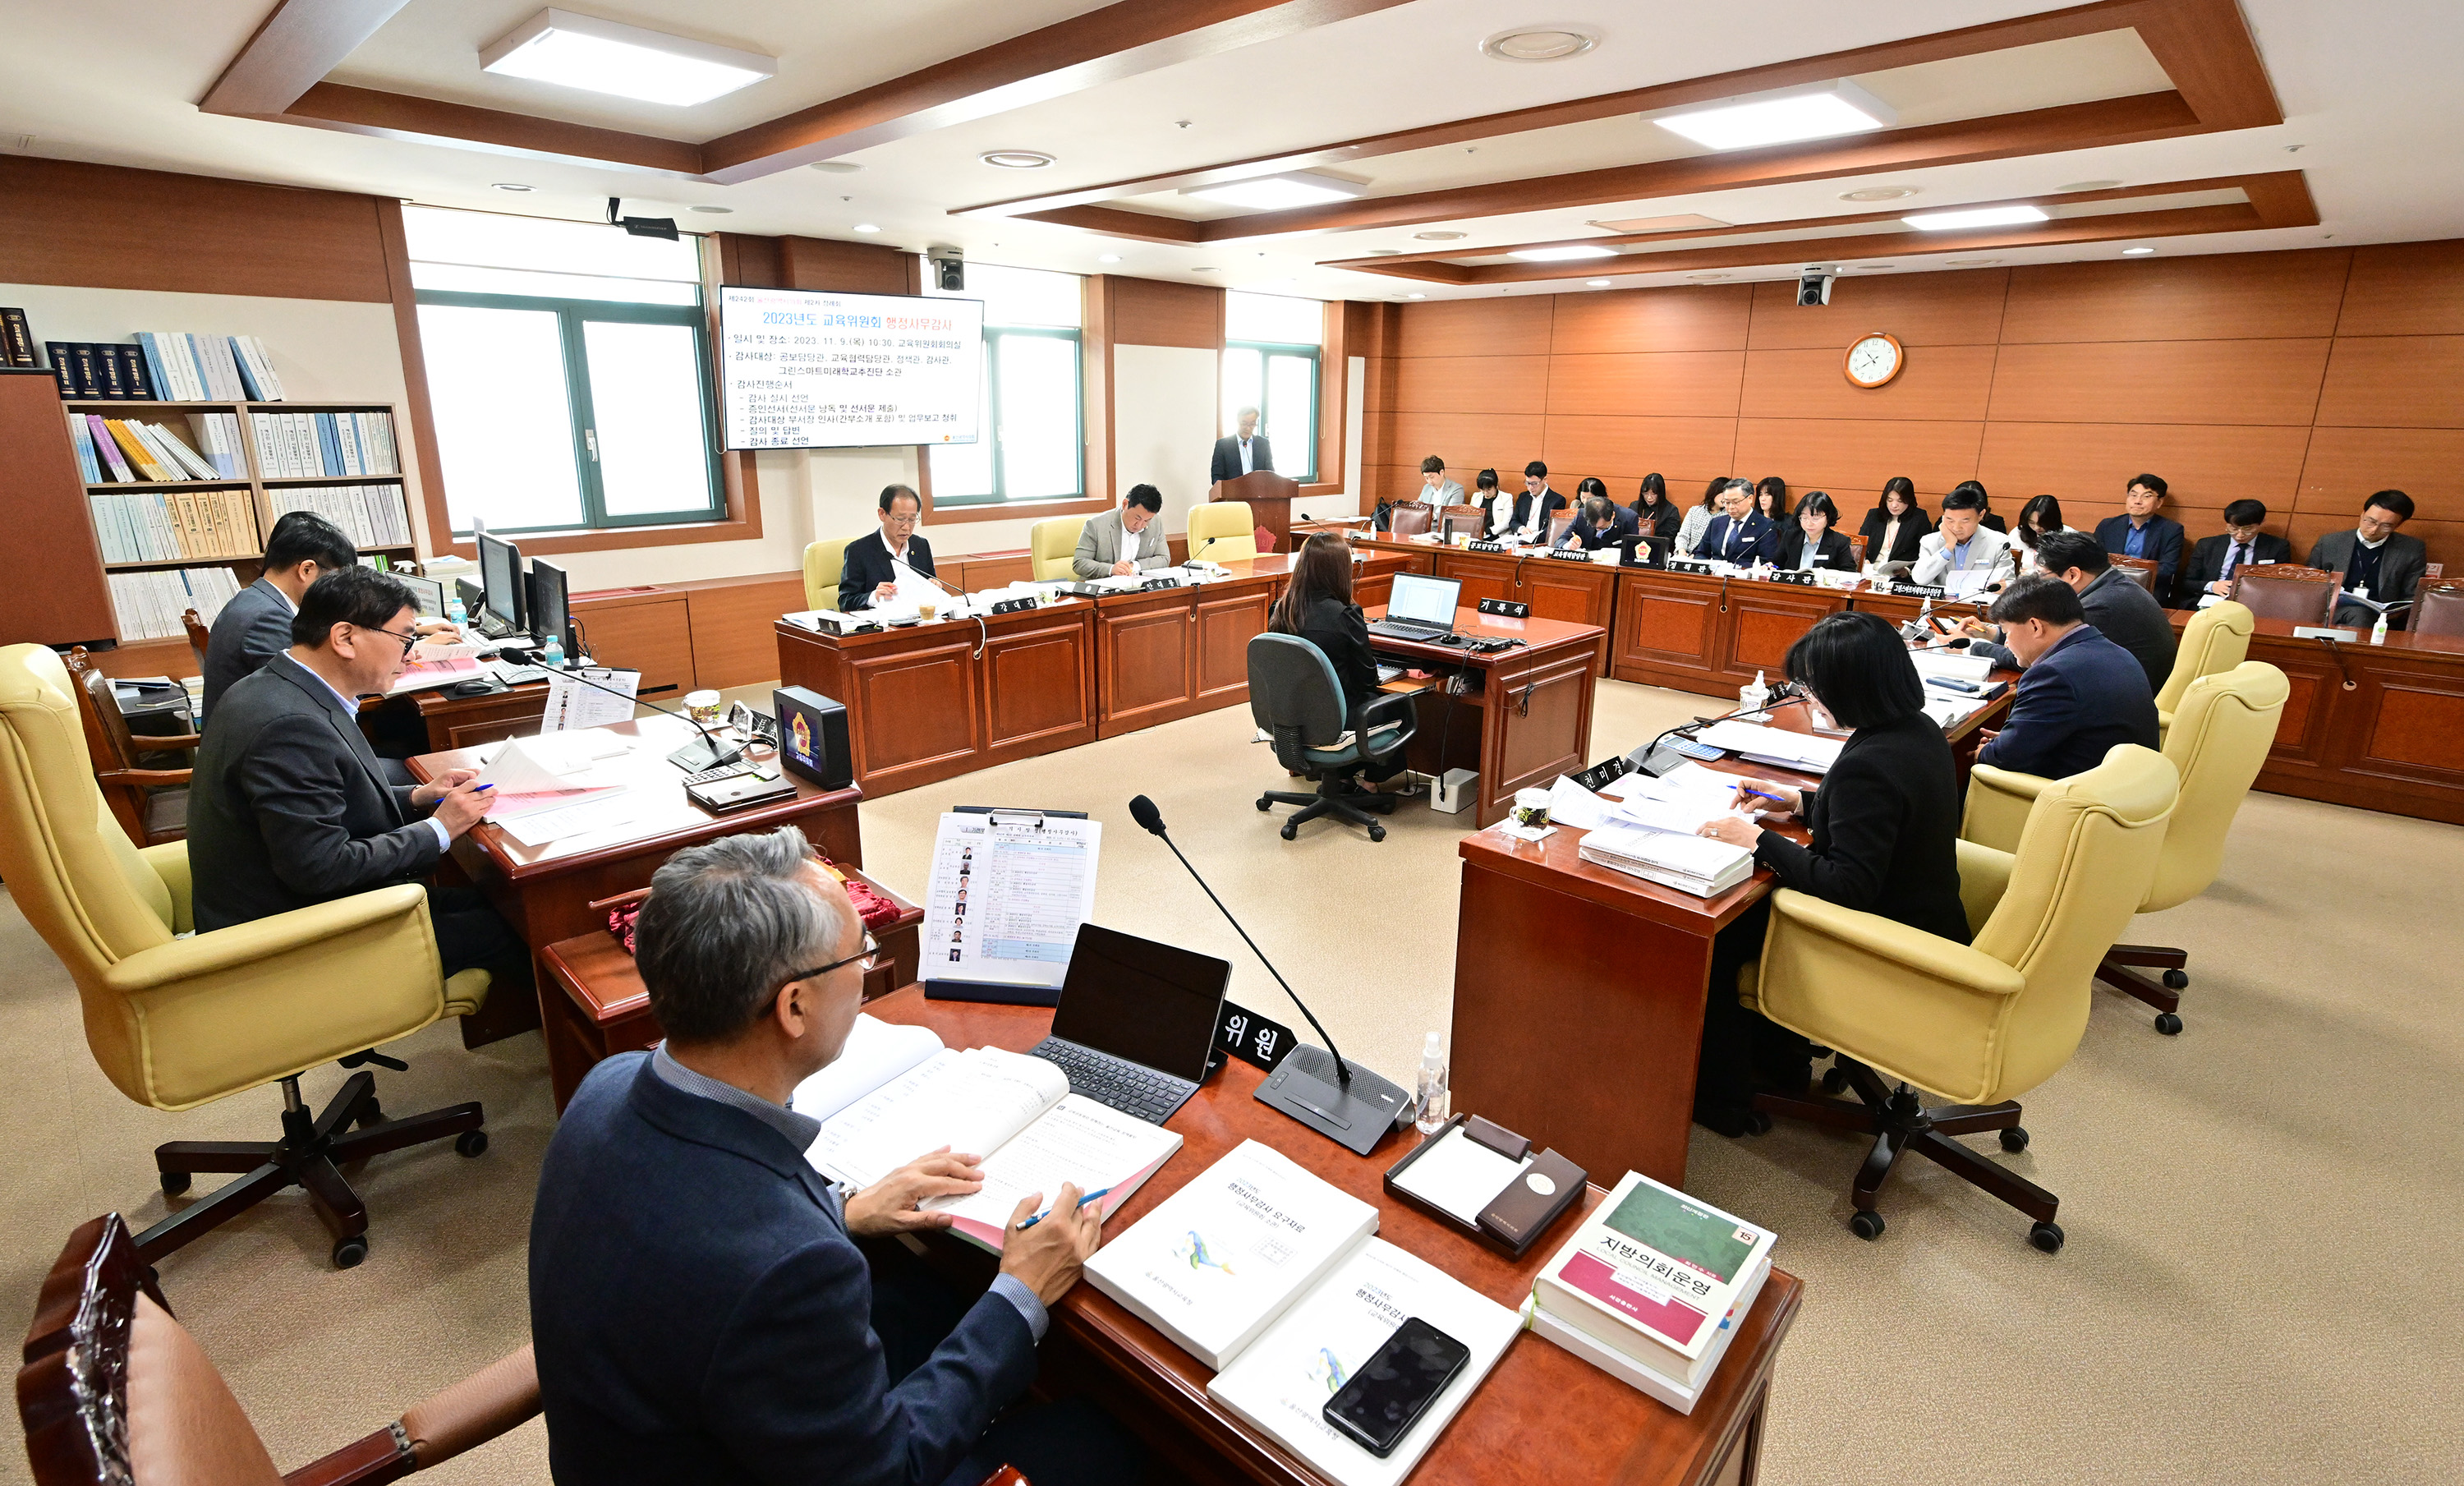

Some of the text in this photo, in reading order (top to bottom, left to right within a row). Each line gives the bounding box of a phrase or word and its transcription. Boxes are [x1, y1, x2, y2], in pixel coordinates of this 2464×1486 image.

[763, 311, 952, 331] 2023년도 교육위원회 행정사무감사
[733, 334, 752, 344] 일시
[756, 334, 765, 345] 및
[769, 334, 790, 345] 장소:
[794, 336, 819, 345] 2023.
[824, 337, 836, 345] 11.
[735, 351, 775, 362] 감사대상:
[885, 367, 902, 377] 소관
[737, 380, 793, 390] 감사진행순서
[748, 393, 809, 403] 감사 실시 선언
[839, 404, 848, 413] 및
[749, 415, 785, 426] 감사대상
[749, 426, 800, 436] 질의 및 답변
[749, 436, 810, 447] 감사 종료 선언
[1772, 572, 1813, 585] 감사관
[1000, 599, 1035, 612] 강대길
[1481, 600, 1524, 615] 기록석
[1584, 760, 1623, 789] 천미경
[1225, 1014, 1279, 1061] 위원
[1228, 1182, 1306, 1234] 행정사무감사 요구자료
[1740, 1231, 1753, 1241] 15
[1600, 1235, 1712, 1296] 지방의회운영
[1596, 1246, 1618, 1260] LOCAL
[1620, 1258, 1649, 1277] COUNCIL
[1650, 1273, 1701, 1301] MANAGEMENT
[1363, 1281, 1393, 1302] 2023년도
